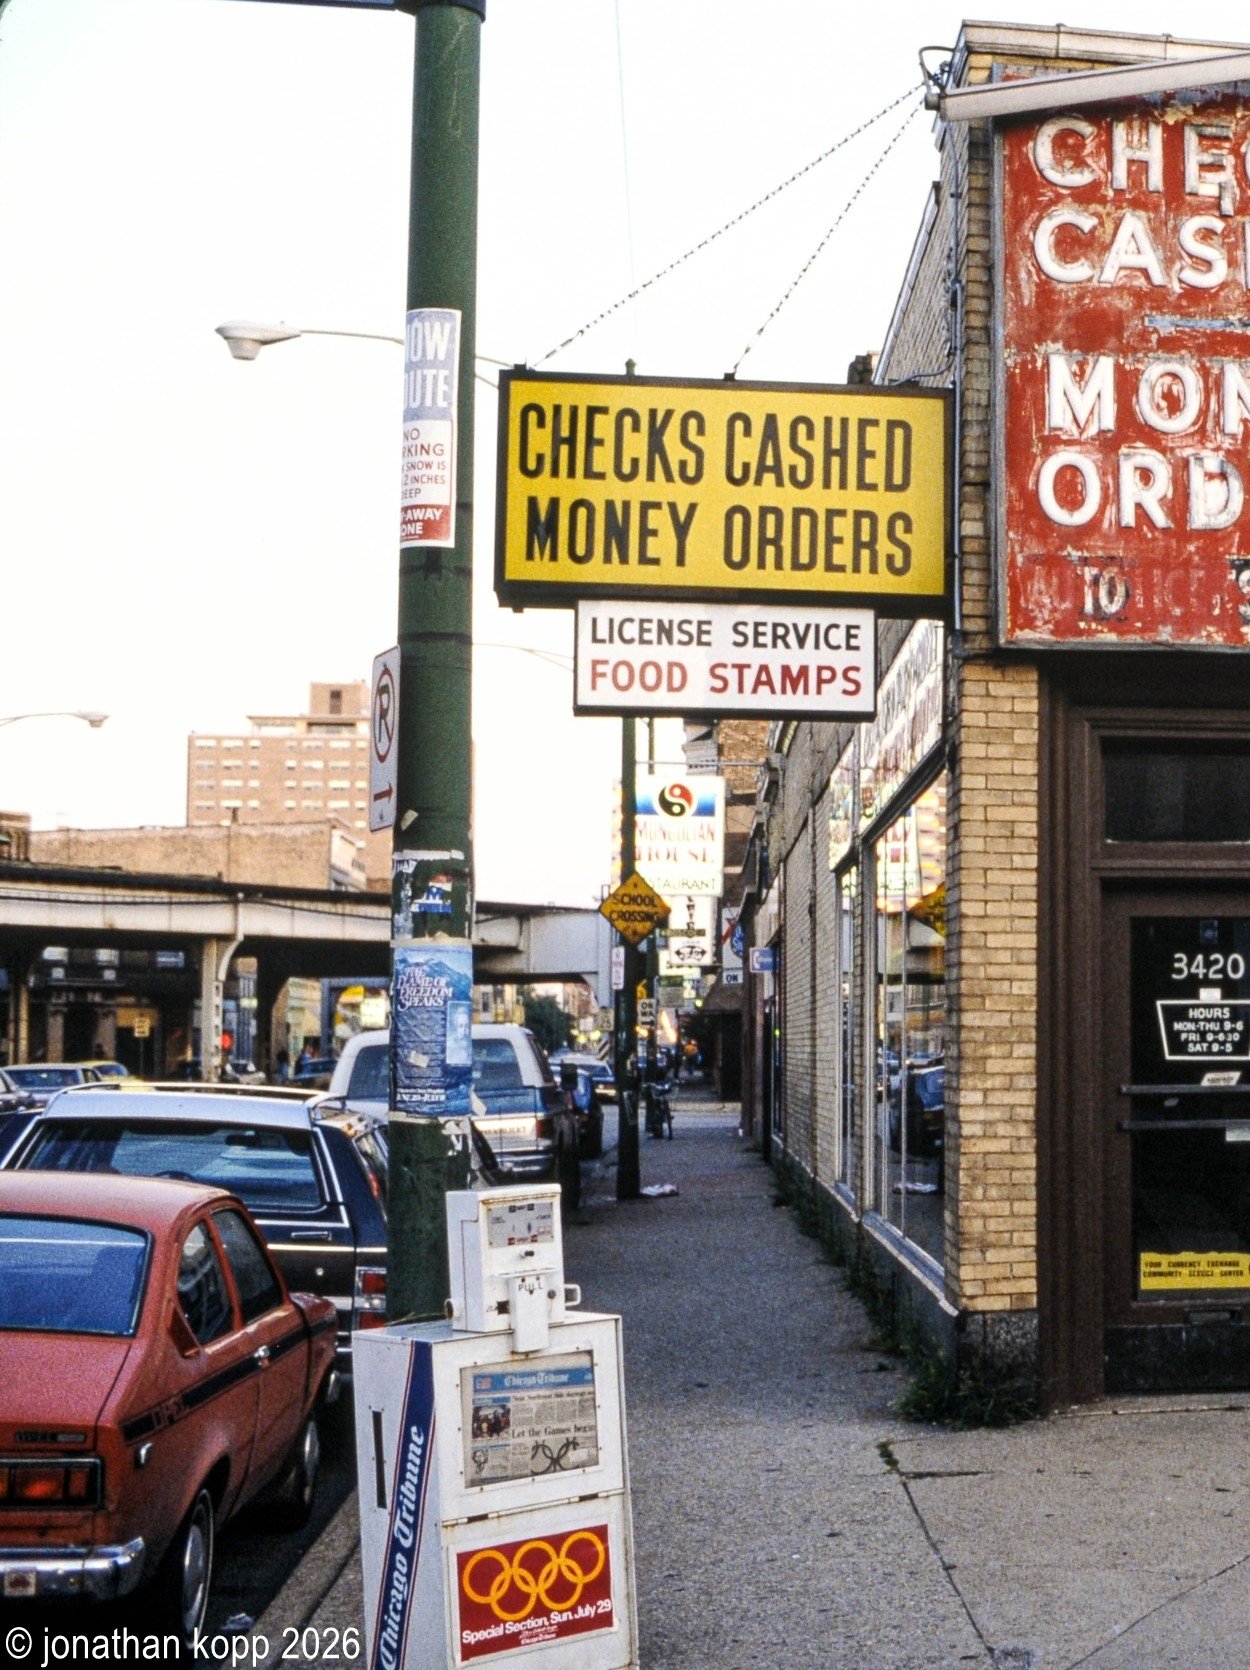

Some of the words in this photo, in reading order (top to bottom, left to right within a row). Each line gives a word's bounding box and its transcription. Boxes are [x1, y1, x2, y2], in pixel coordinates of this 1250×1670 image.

[406, 320, 451, 362] OW
[403, 369, 449, 408] UTE
[402, 443, 445, 457] RKING
[518, 402, 705, 486] CHECKS
[724, 411, 913, 492] CASHED
[405, 461, 434, 471] SNOW
[437, 461, 446, 471] IS
[410, 474, 446, 486] INCHES
[400, 507, 443, 522] -AWAY
[401, 521, 424, 536] ONE
[525, 496, 699, 568] MONEY
[723, 504, 914, 577] ORDERS
[590, 617, 713, 648] LICENSE
[731, 621, 861, 652] SERVICE
[590, 660, 688, 693] FOOD
[709, 662, 862, 697] STAMPS
[649, 878, 717, 891] STAURANT
[613, 893, 657, 908] SCHOOL
[609, 910, 658, 923] CROSSING
[1171, 953, 1245, 980] 3420
[400, 986, 453, 1001] FREEDOM
[398, 996, 444, 1011] SPEAKS
[1188, 1007, 1230, 1019] HOURS
[1223, 1021, 1243, 1031] 9-6
[1167, 1260, 1201, 1268] CURRENCY
[1206, 1259, 1240, 1267] EXCHANGE
[1142, 1270, 1182, 1278] COMMUNITY
[518, 1282, 543, 1291] PULL
[511, 1430, 525, 1438] Let
[528, 1428, 541, 1437] the
[544, 1426, 571, 1435] Games
[394, 1425, 424, 1549] Tribune
[380, 1552, 409, 1669] Chicago
[462, 1624, 505, 1645] Special
[505, 1616, 549, 1634] Section,
[550, 1611, 572, 1625] Sun.
[574, 1604, 597, 1619] July
[597, 1598, 612, 1613] 29
